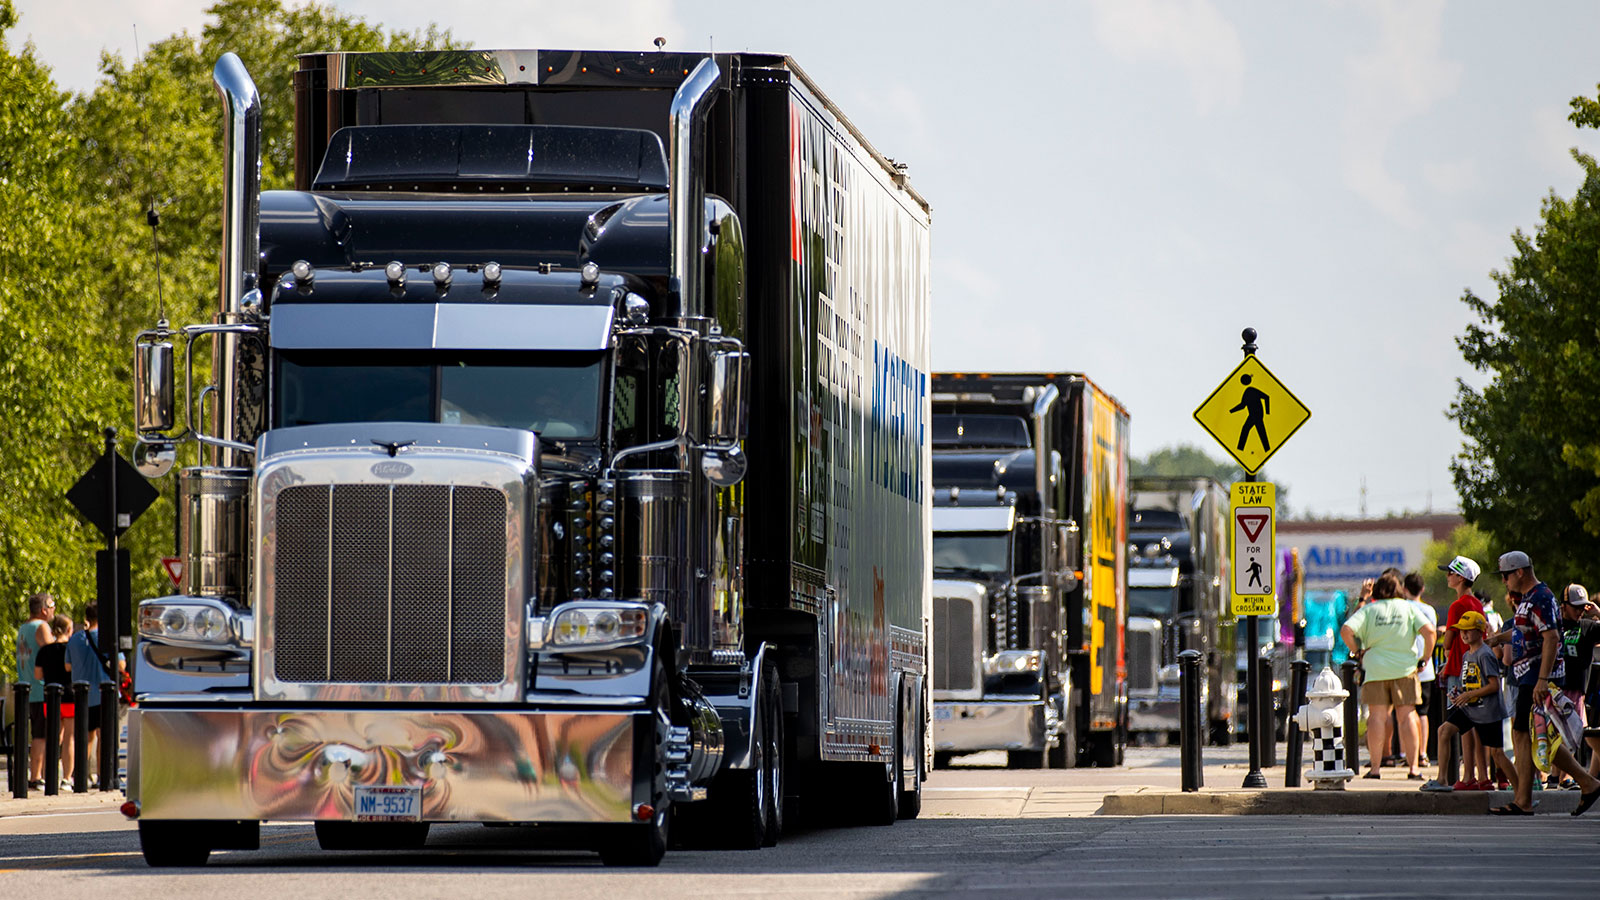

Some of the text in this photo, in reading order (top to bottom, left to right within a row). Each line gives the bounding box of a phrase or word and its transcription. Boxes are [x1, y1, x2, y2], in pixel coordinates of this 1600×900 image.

[1239, 486, 1267, 495] STATE
[1243, 496, 1262, 504] LAW
[1303, 545, 1405, 565] Allison
[360, 796, 413, 813] NM-9537
